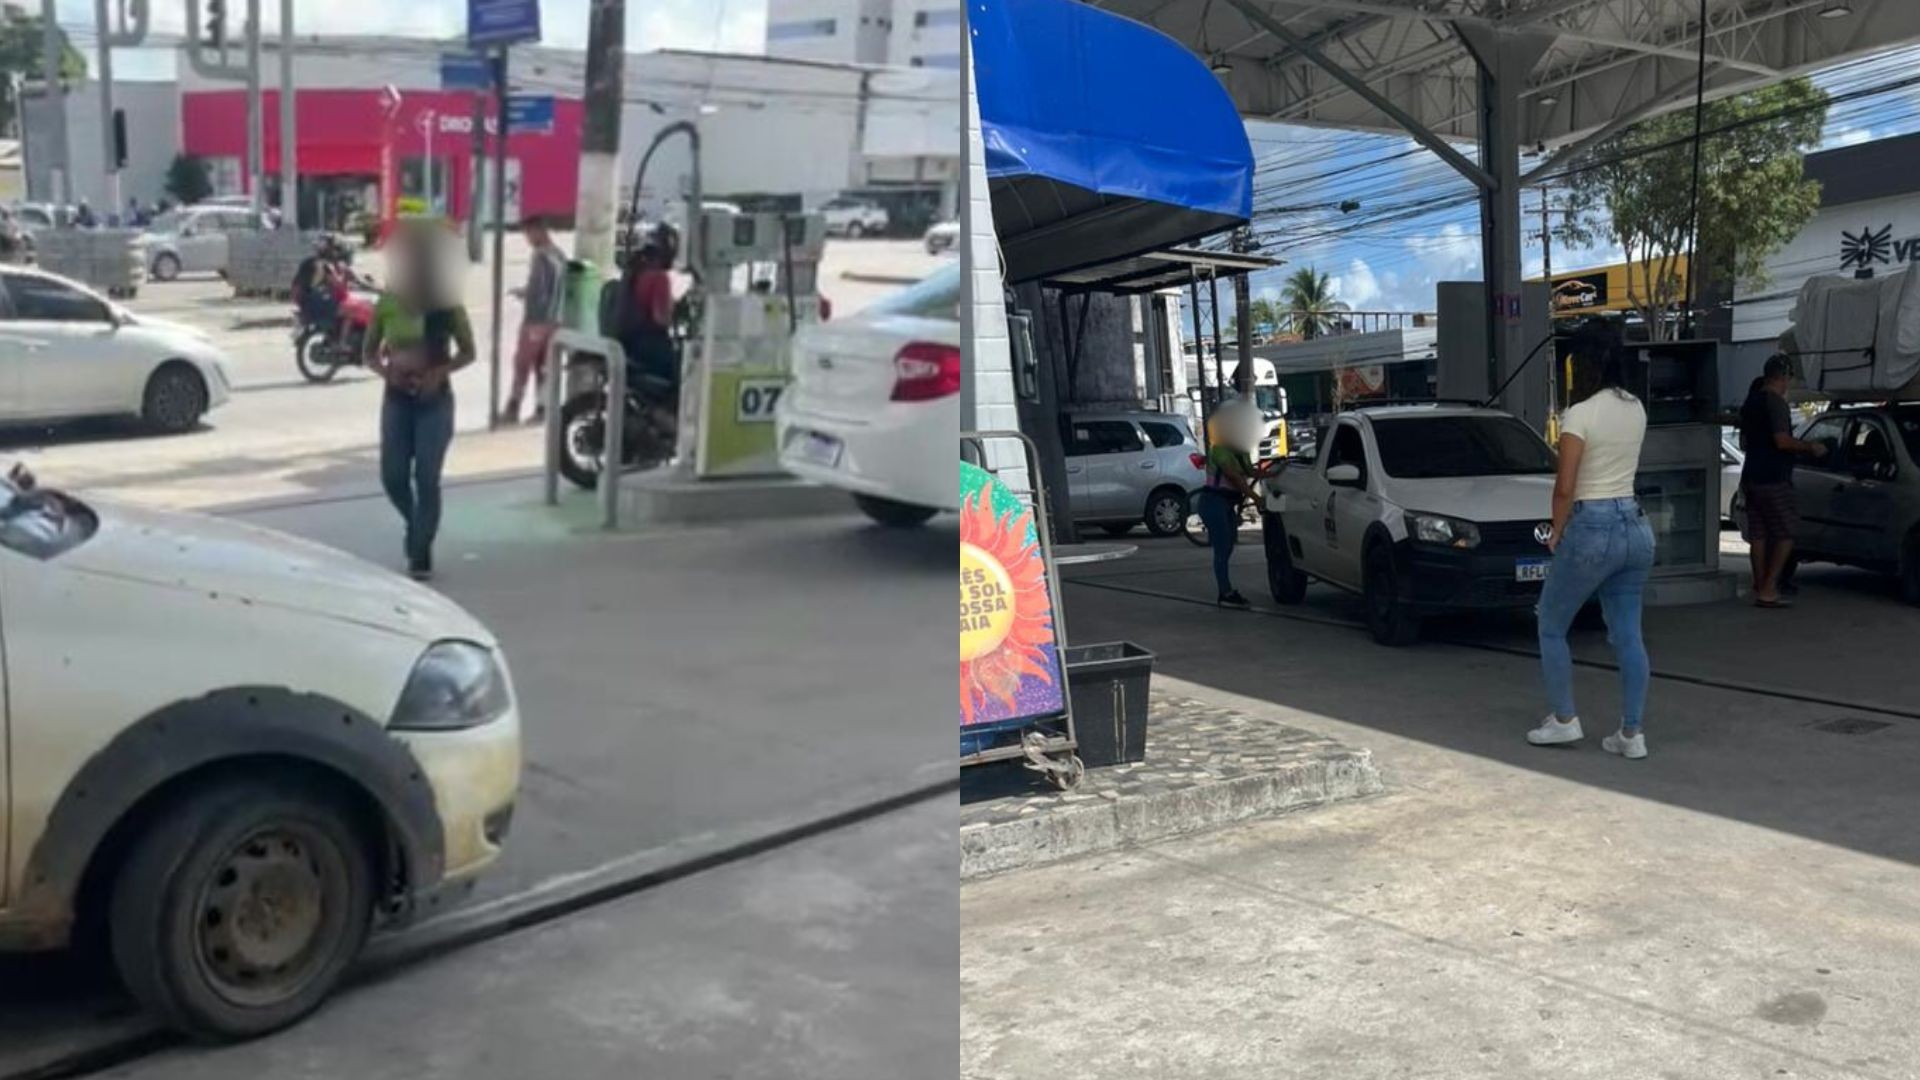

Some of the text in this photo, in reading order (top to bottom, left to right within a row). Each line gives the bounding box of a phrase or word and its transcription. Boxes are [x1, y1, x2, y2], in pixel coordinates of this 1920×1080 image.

[742, 387, 783, 415] 07
[960, 567, 986, 585] ÊS
[969, 581, 1006, 599] SOL
